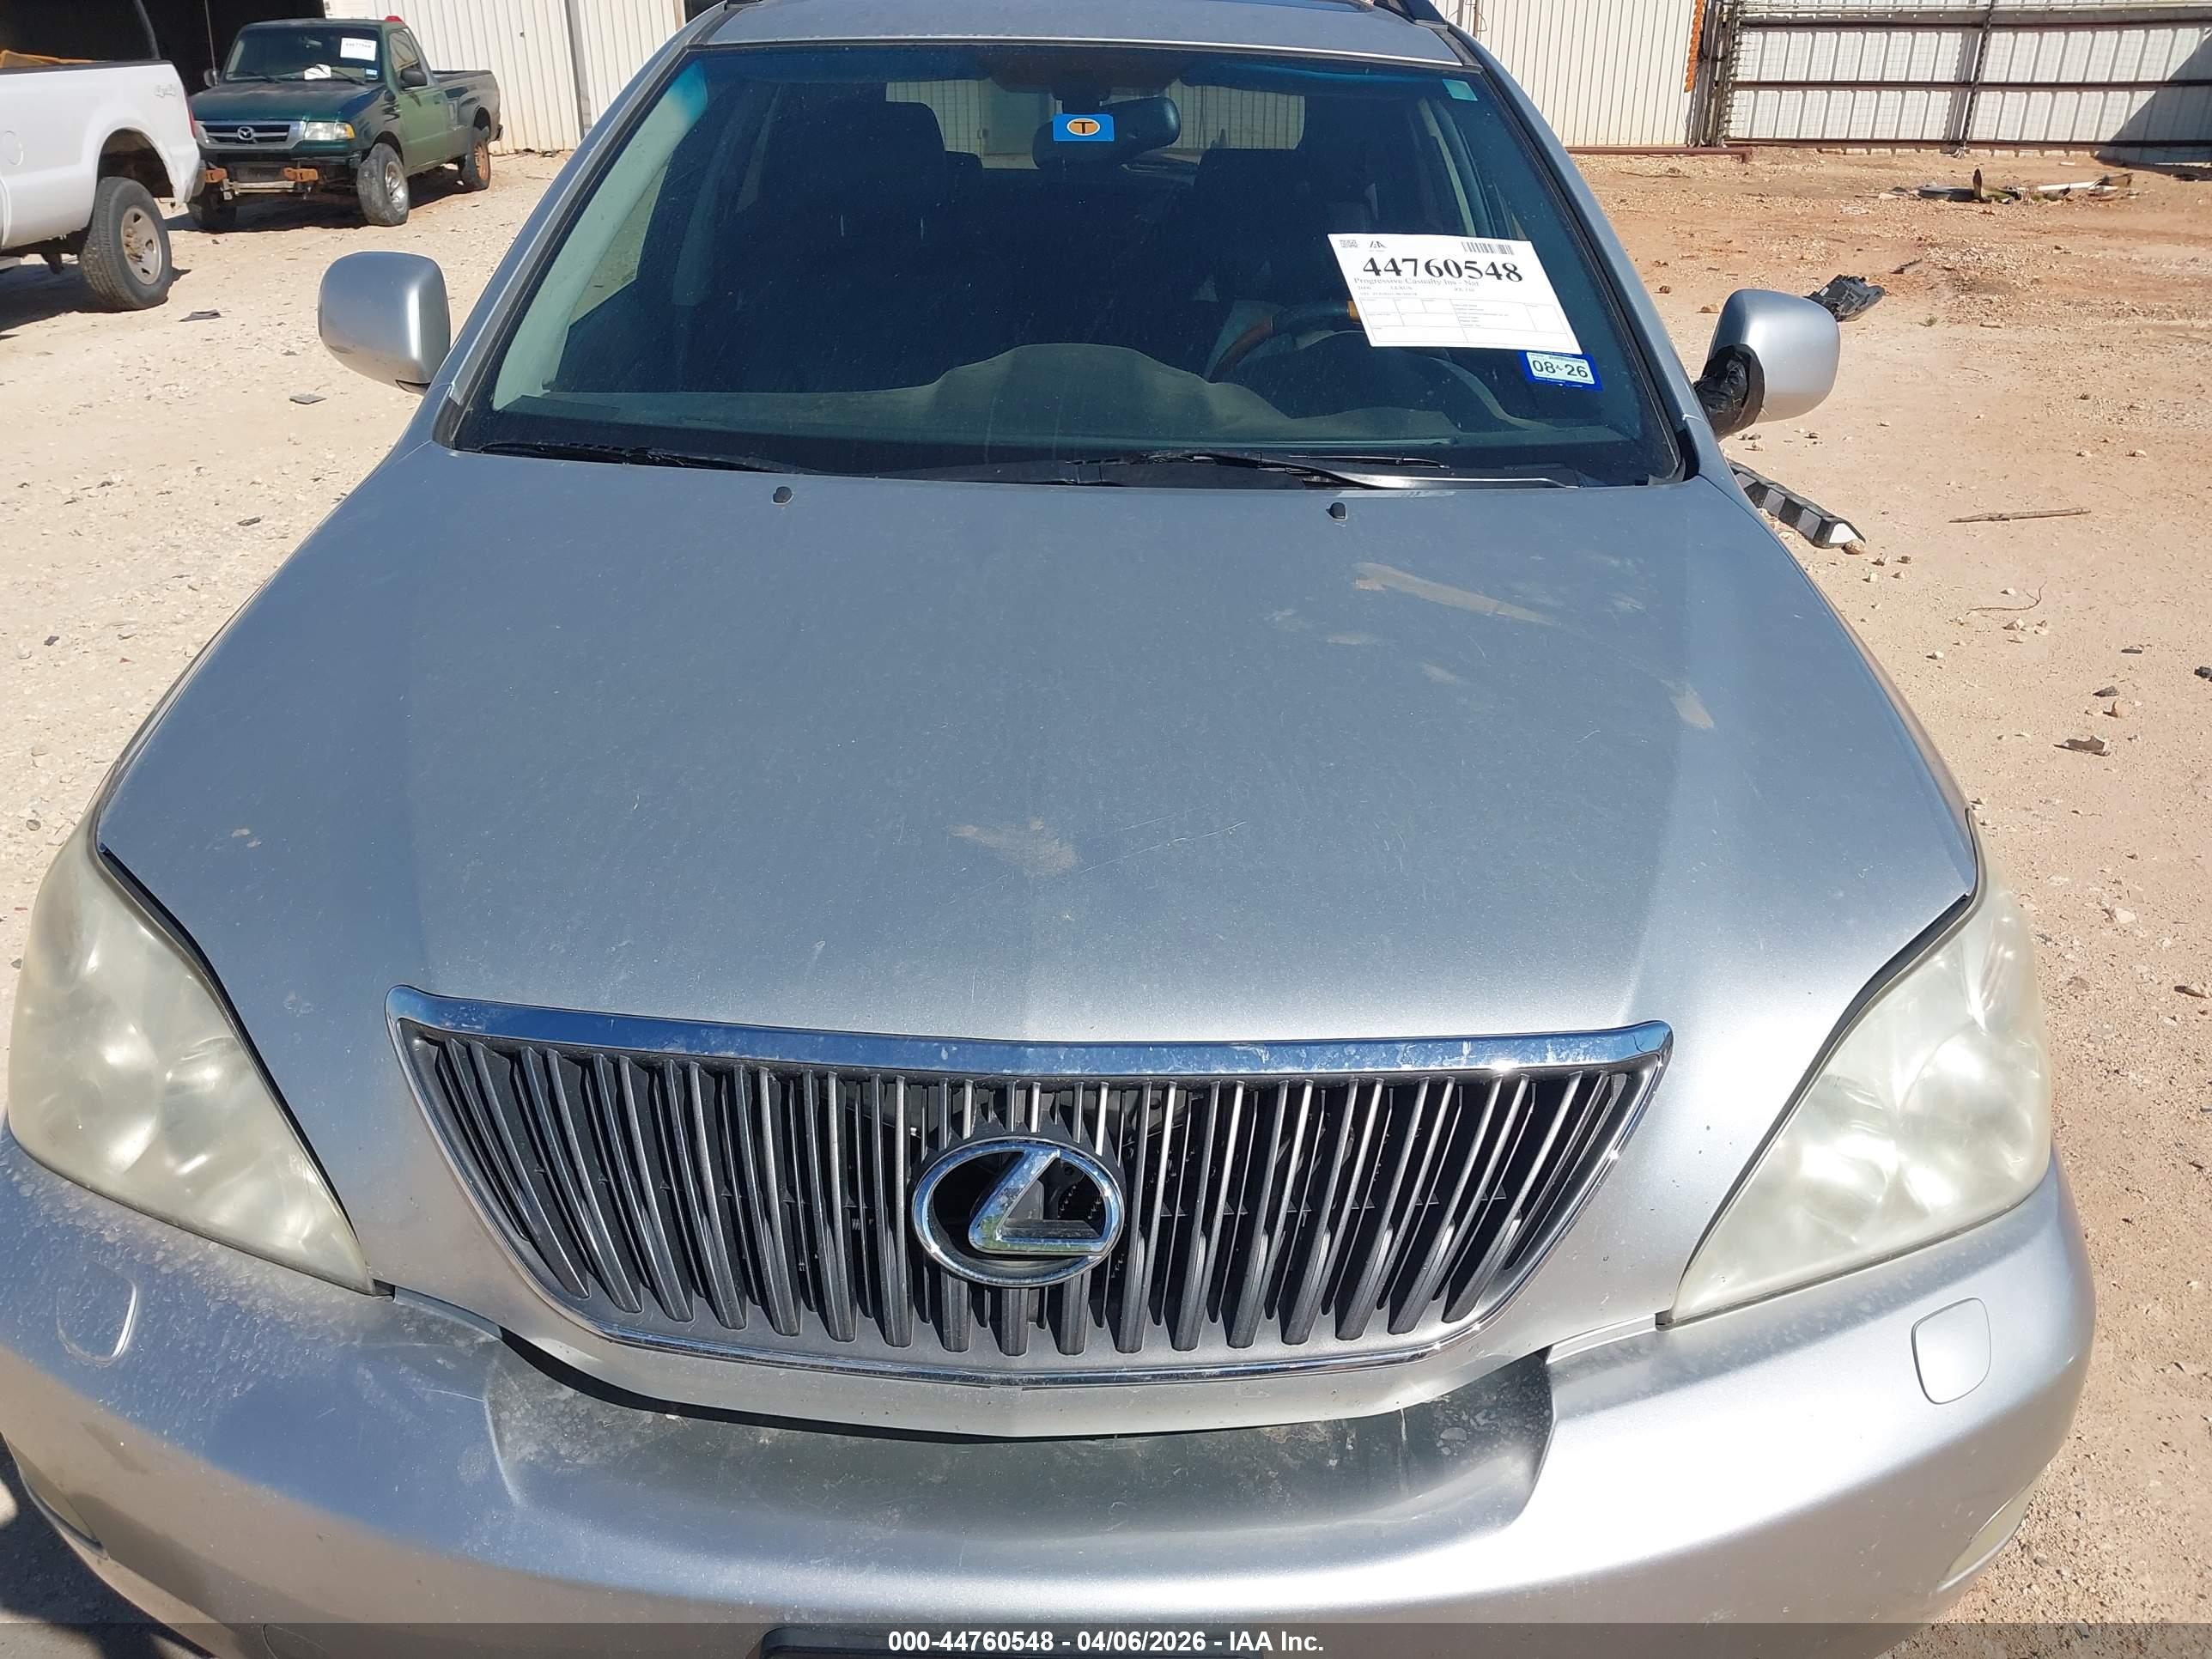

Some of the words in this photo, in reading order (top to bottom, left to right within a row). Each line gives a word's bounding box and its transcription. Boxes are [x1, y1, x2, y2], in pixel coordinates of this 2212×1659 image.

[1073, 121, 1094, 134] T
[1363, 257, 1523, 283] 44760548
[1353, 276, 1403, 285] Progressive
[1405, 276, 1442, 287] Casualty
